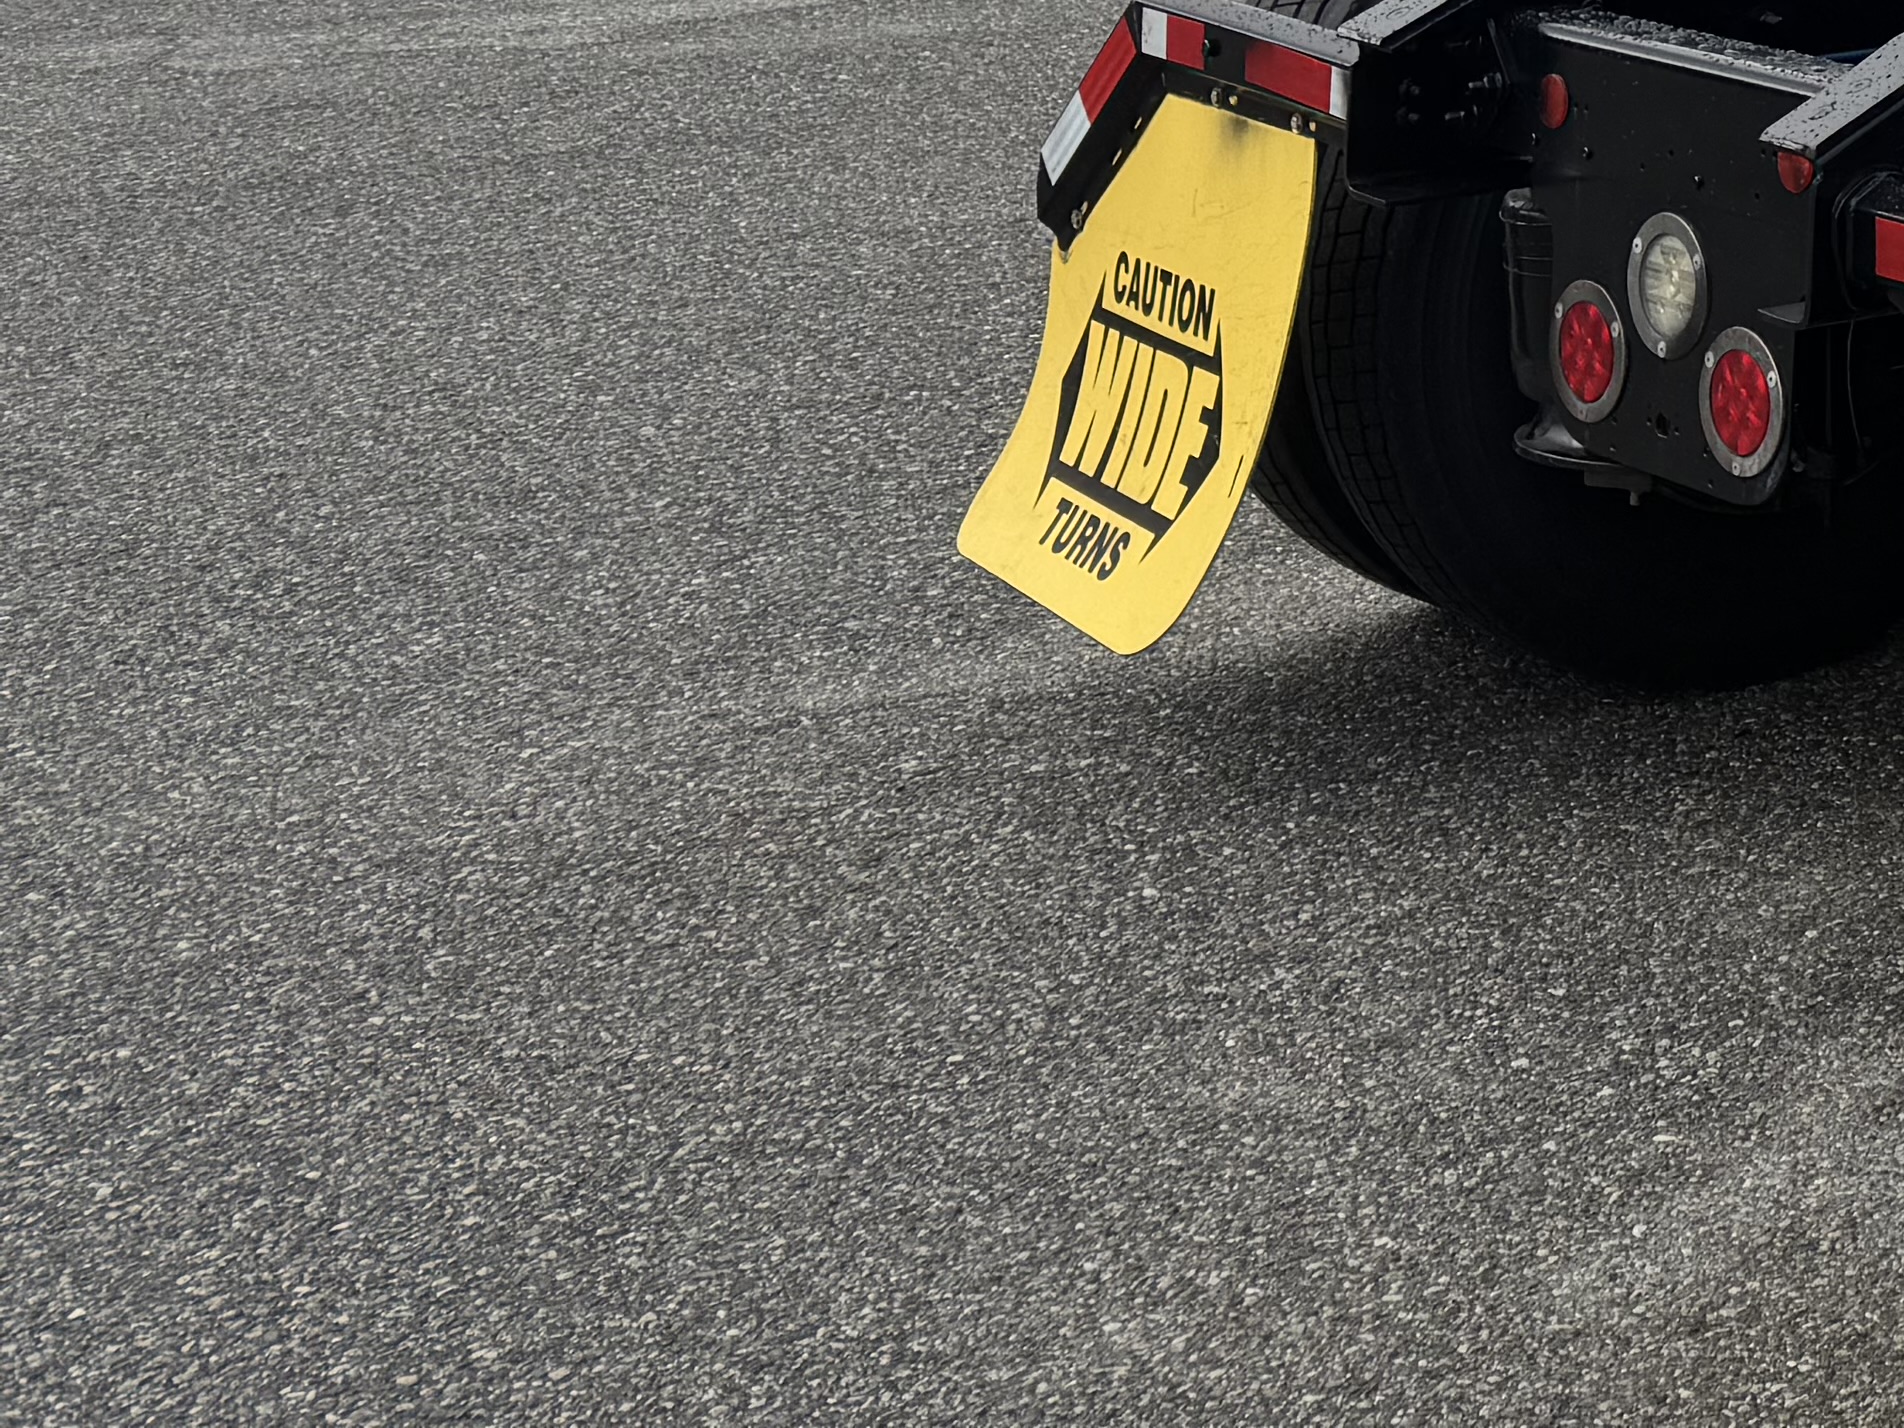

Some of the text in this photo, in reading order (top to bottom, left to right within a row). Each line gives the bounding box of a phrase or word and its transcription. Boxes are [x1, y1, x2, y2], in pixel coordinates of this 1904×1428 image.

[1111, 249, 1217, 343] CAUTION
[1060, 326, 1223, 521] WIDE
[1039, 495, 1133, 583] TURNS
